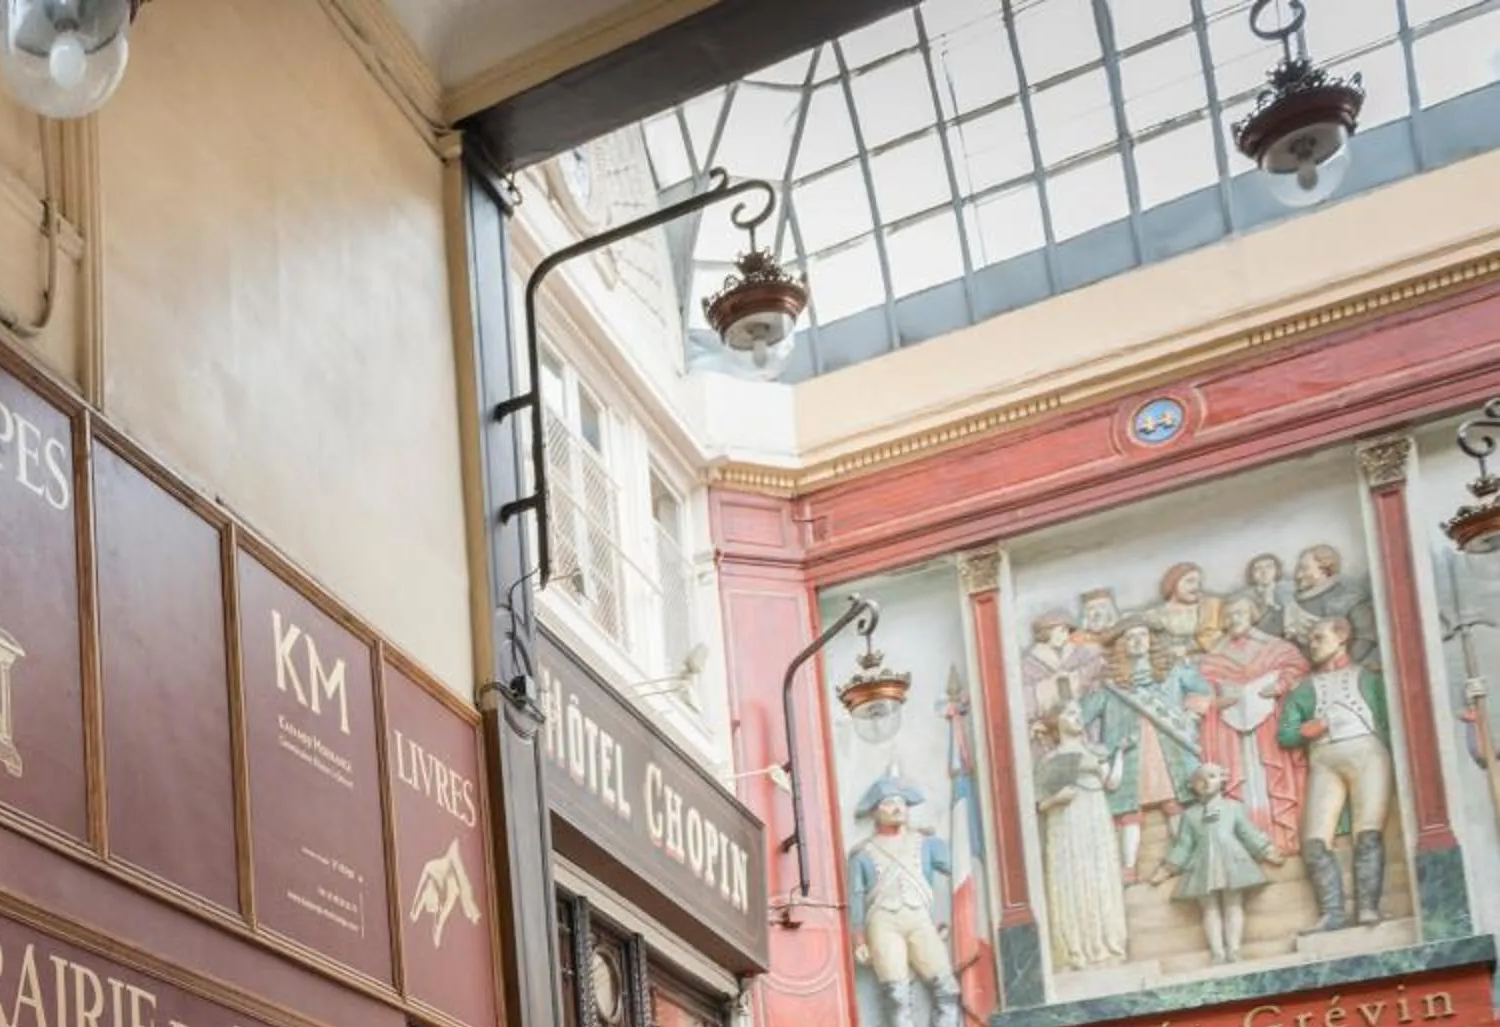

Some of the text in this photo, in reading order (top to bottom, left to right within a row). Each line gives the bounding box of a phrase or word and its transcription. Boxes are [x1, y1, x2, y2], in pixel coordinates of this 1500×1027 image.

[271, 610, 351, 734] KM
[393, 729, 477, 828] LIVRES
[539, 666, 631, 819] HÔTEL
